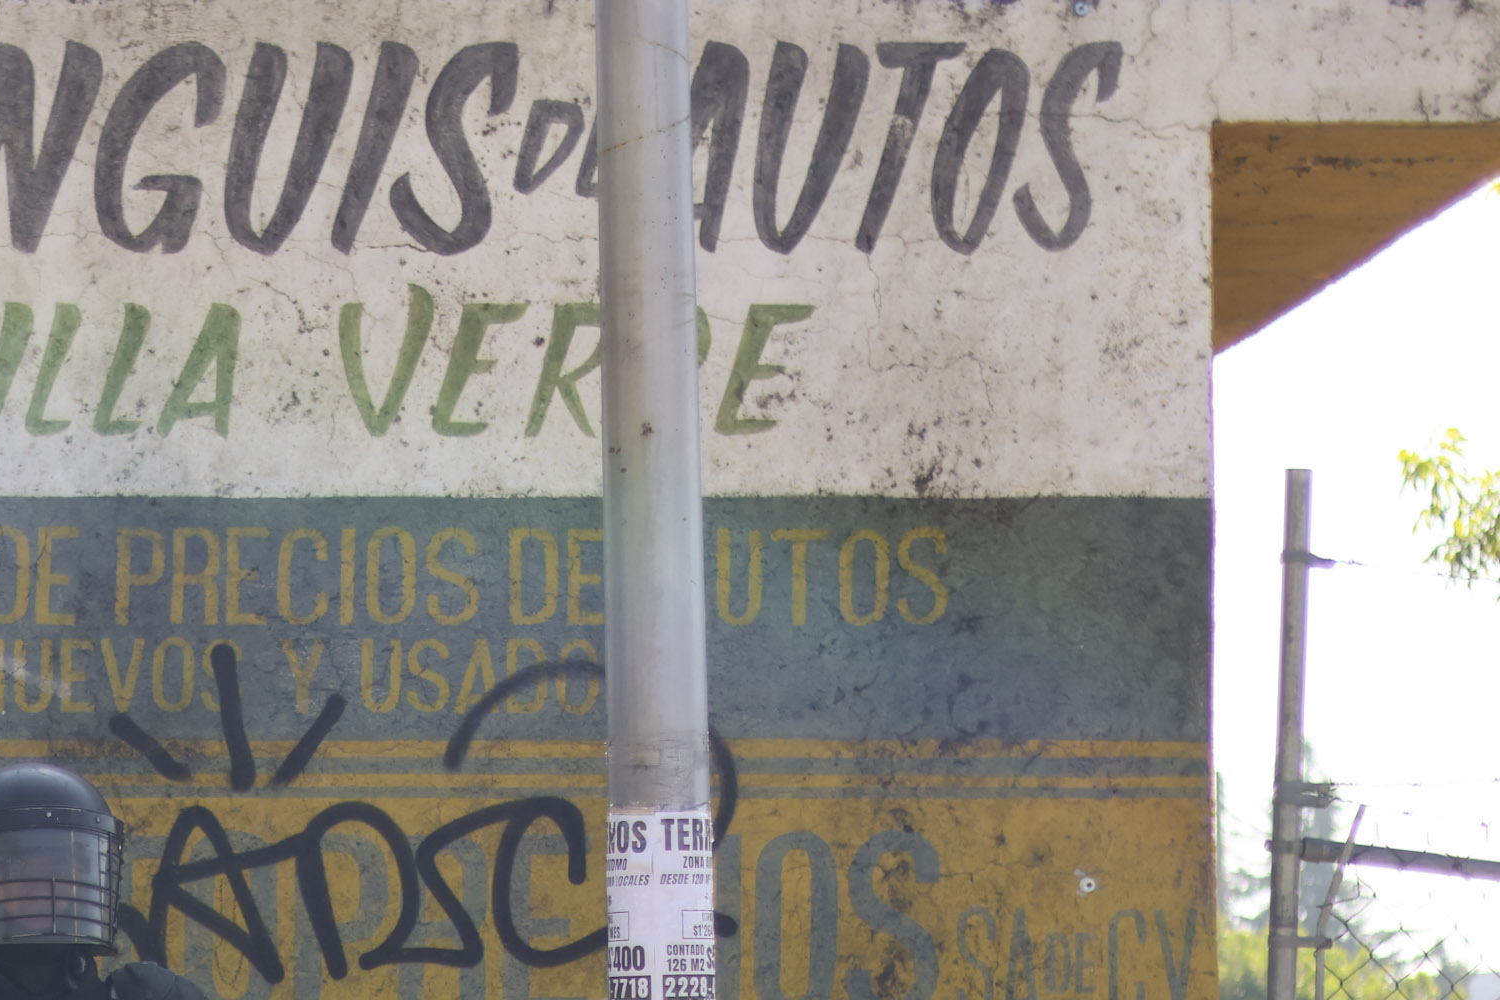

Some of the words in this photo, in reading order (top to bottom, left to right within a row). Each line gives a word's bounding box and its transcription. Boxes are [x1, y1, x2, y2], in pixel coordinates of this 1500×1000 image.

[513, 99, 600, 198] D
[337, 283, 817, 437] VERE
[114, 525, 480, 626] PRECIOS
[508, 527, 604, 627] DE
[715, 526, 950, 627] UTOS
[279, 637, 325, 715] Y
[359, 637, 600, 717] USADO
[659, 873, 690, 886] DESDE
[666, 944, 705, 957] CONTADO
[666, 957, 688, 972] 126
[690, 957, 706, 972] M2
[1043, 931, 1098, 995] DE
